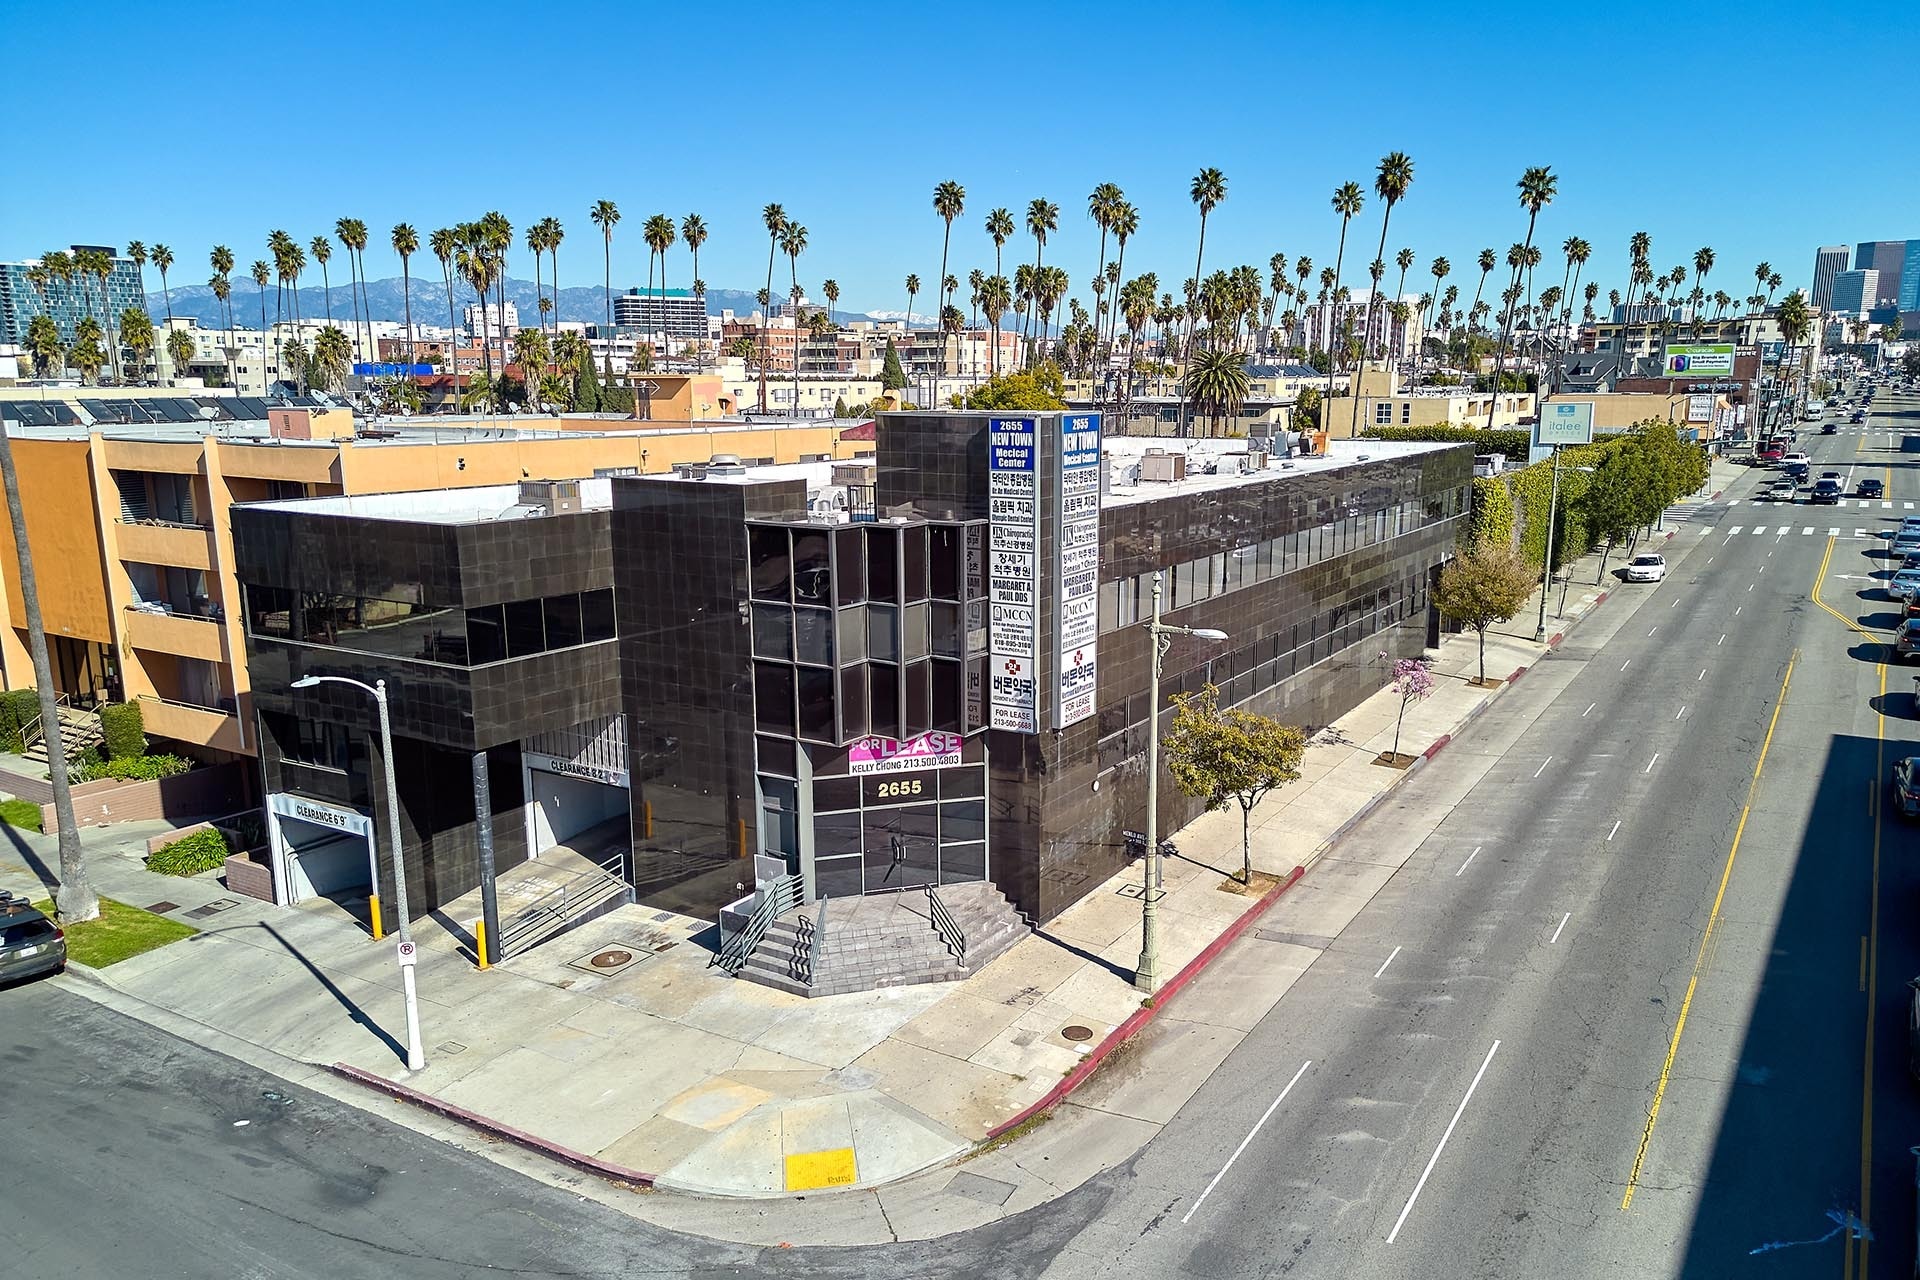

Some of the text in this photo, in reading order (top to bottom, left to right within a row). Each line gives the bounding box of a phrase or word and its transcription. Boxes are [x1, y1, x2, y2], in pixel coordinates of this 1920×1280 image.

[1000, 421, 1023, 431] 2655
[1072, 418, 1089, 430] 2655
[1549, 420, 1581, 430] italee
[992, 432, 1033, 446] NEW TOWN
[1063, 430, 1098, 452] NEW TOWN
[998, 458, 1026, 468] Center
[1082, 452, 1097, 464] Center
[992, 499, 1033, 514] 올림픽 치과
[1063, 495, 1097, 513] 올림픽 치과
[1003, 527, 1033, 540] Chiropractic
[1074, 520, 1097, 535] Chiropractic
[998, 553, 1026, 565] 창세기
[994, 564, 1030, 576] 척추병원
[992, 579, 1026, 592] MARGARET
[1063, 573, 1090, 589] MARGARET
[998, 590, 1028, 603] PAUL DDS
[1069, 582, 1093, 598] PAUL DDS
[1003, 608, 1032, 621] MCCN
[1062, 662, 1094, 689] 버몬약국
[993, 675, 1032, 697] 버몬약국
[1065, 695, 1090, 713] FOR LEASE
[995, 708, 1030, 720] FOR LEASE
[851, 733, 958, 757] FOR LEASE
[551, 760, 590, 777] CLEARANCE
[852, 755, 959, 773] KELLY CHONG 213.500.4803
[878, 779, 922, 798] 2655
[296, 805, 333, 823] CLEARANCE
